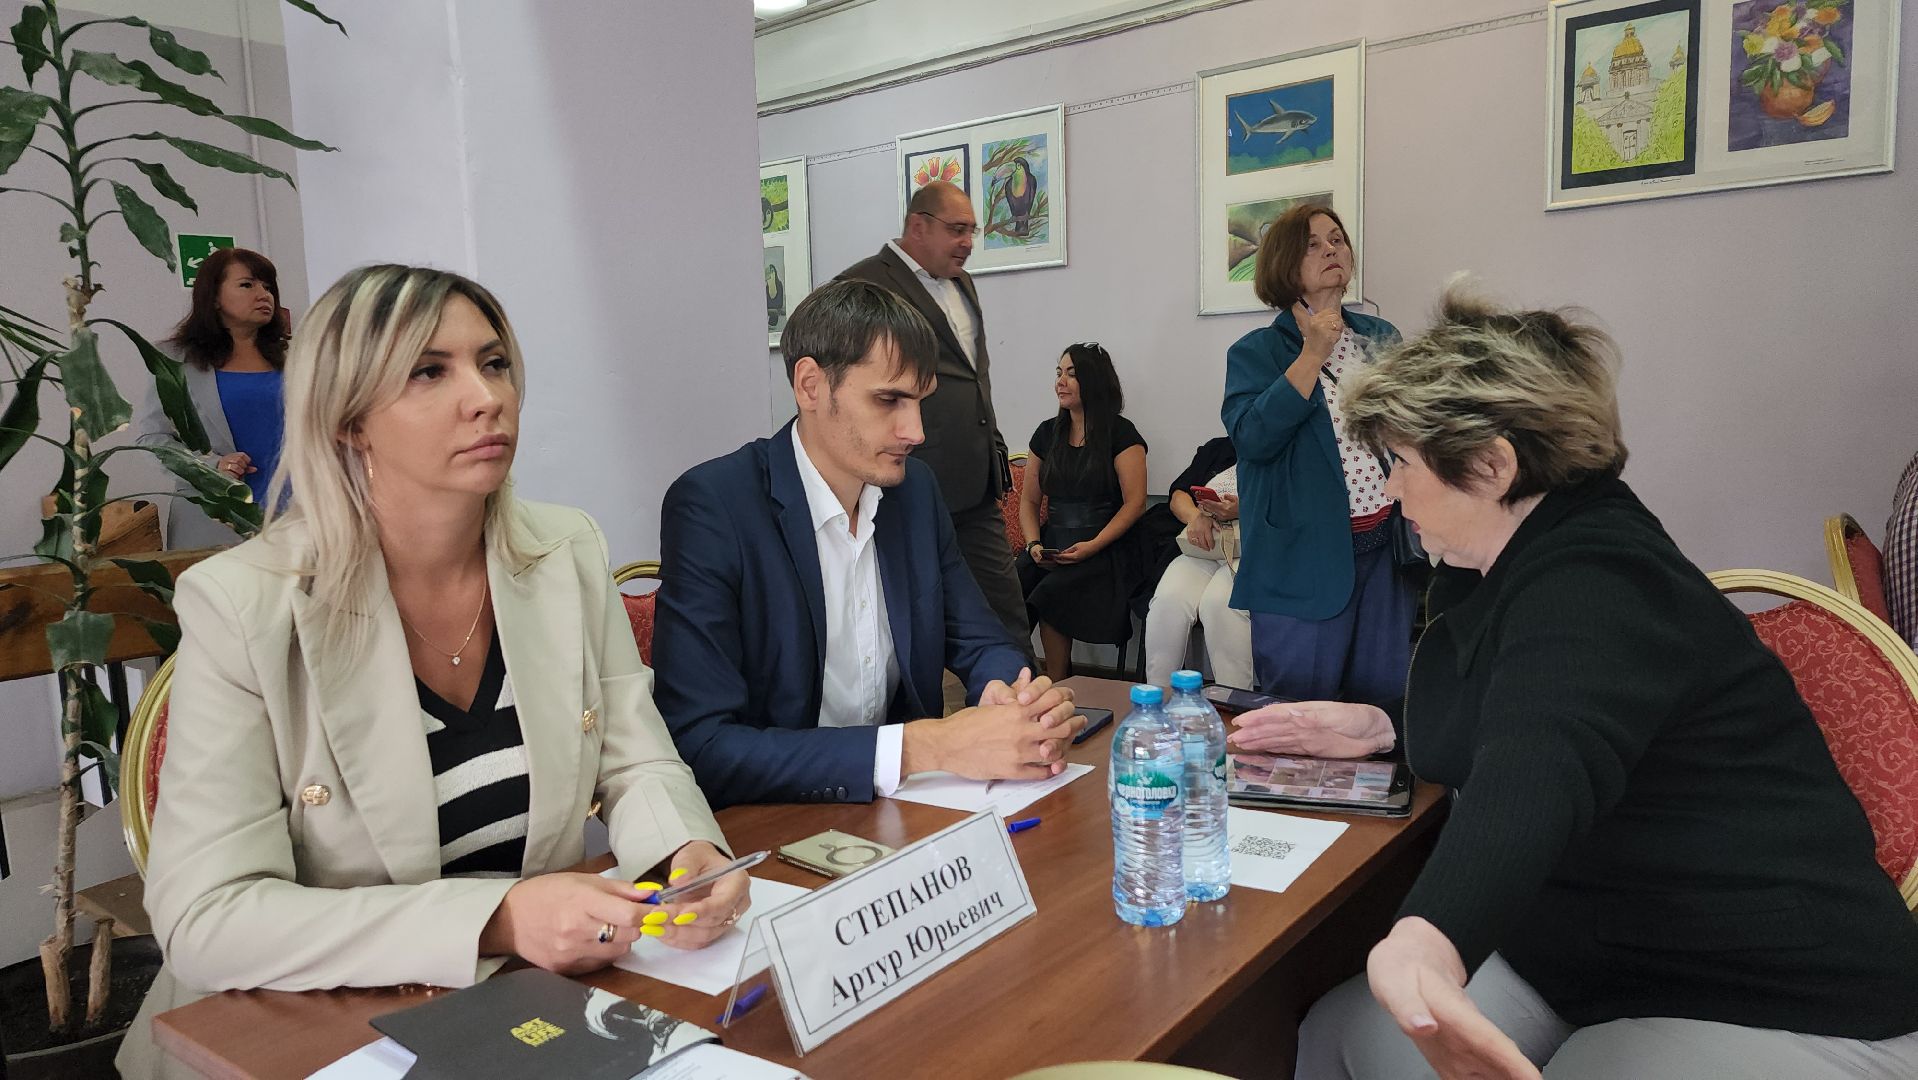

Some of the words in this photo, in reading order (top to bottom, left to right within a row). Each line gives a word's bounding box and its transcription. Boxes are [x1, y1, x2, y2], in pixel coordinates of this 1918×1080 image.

[832, 949, 904, 1007] Артур
[906, 891, 1004, 953] Юрьевич
[835, 855, 972, 946] СТЕПАНОВ
